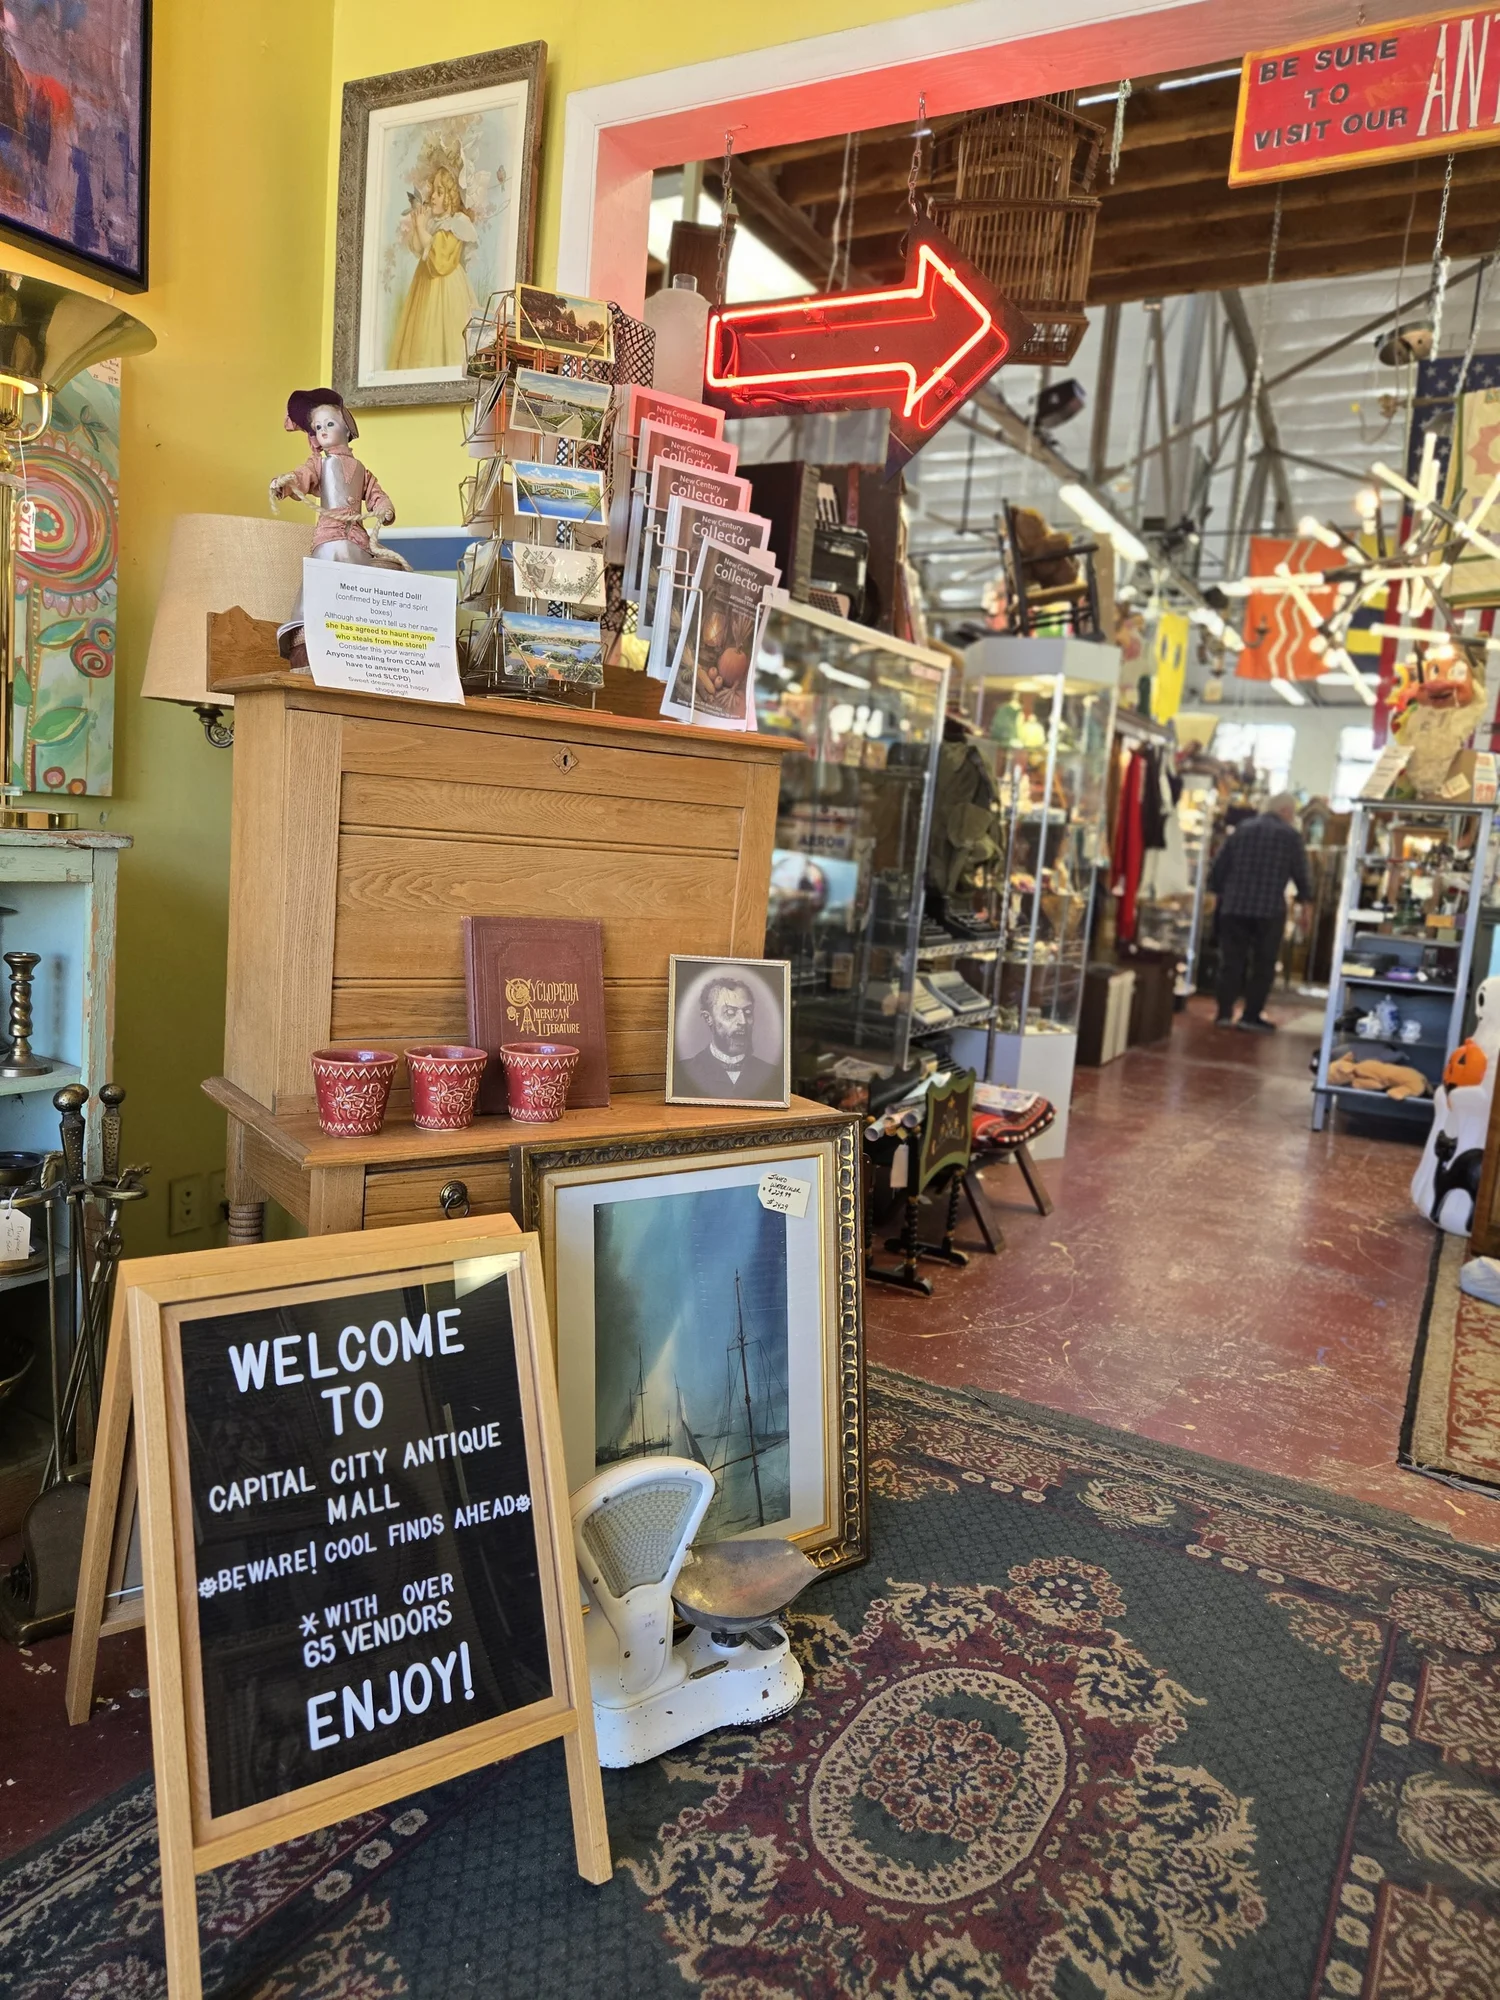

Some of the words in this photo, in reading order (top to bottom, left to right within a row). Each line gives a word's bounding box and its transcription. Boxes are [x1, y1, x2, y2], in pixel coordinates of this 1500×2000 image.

[1259, 57, 1299, 84] BE
[1315, 37, 1399, 72] SURE
[1304, 82, 1349, 111] TO
[1254, 119, 1332, 152] VISIT
[1341, 106, 1408, 136] OUR
[656, 405, 672, 416] New
[672, 409, 698, 423] Century
[671, 441, 686, 452] New
[686, 445, 712, 460] Century
[670, 481, 728, 507] Collector
[679, 475, 695, 486] New
[695, 479, 721, 493] Century
[692, 522, 750, 547] Collector
[702, 515, 718, 527] New
[718, 519, 743, 533] Century
[714, 563, 763, 594] Collector
[724, 557, 738, 569] New
[736, 564, 758, 579] Century
[335, 592, 371, 604] (confirmed
[372, 597, 380, 606] by
[381, 599, 397, 607] EMF
[399, 602, 411, 610] and
[412, 603, 429, 612] spirit
[340, 582, 358, 592] Meet
[359, 586, 372, 594] our
[373, 587, 404, 598] Haunted
[405, 592, 422, 601] Doll!
[324, 611, 354, 623] Although
[355, 615, 368, 624] she
[369, 618, 387, 626] won't
[420, 624, 438, 633] name
[370, 607, 393, 618] boxes)
[325, 622, 339, 630] she
[340, 624, 353, 632] has
[355, 626, 380, 636] agreed
[389, 630, 409, 639] haunt
[410, 632, 435, 642] anyone
[335, 633, 351, 641] who
[352, 635, 373, 644] steals
[374, 637, 391, 646] from
[392, 639, 404, 648] the
[326, 649, 354, 660] Anyone
[356, 653, 385, 664] stealing
[386, 656, 404, 665] from
[404, 659, 427, 667] CCAM
[427, 661, 441, 669] will
[338, 642, 368, 652] Consider
[370, 645, 382, 653] this
[383, 648, 398, 656] your
[399, 650, 426, 659] warning!
[345, 661, 364, 669] have
[374, 665, 400, 673] answer
[410, 668, 425, 676] her!
[365, 671, 382, 679] (and
[383, 673, 411, 683] SLCPD)
[348, 676, 370, 684] Sweet
[370, 679, 395, 687] dreams
[396, 681, 409, 689] and
[409, 683, 430, 692] happy
[505, 977, 580, 1007] CYCLOPEDIA
[520, 1006, 570, 1035] AMERICAN
[536, 1019, 580, 1037] LITERATURE
[228, 1308, 465, 1394] WELCOME
[320, 1381, 384, 1436] TO
[208, 1466, 317, 1513] CAPITAL
[330, 1447, 388, 1485] CITY
[402, 1422, 502, 1470] ANTIQUE
[327, 1484, 400, 1526] MALL
[217, 1541, 318, 1594] BEWARE!
[324, 1532, 378, 1564] COOL
[388, 1513, 446, 1547] FINDS
[454, 1494, 516, 1530] AHEAD
[402, 1572, 455, 1606] OVER
[303, 1634, 337, 1669] 65
[342, 1599, 453, 1656] VENDORS
[306, 1640, 475, 1752] ENJOY!
